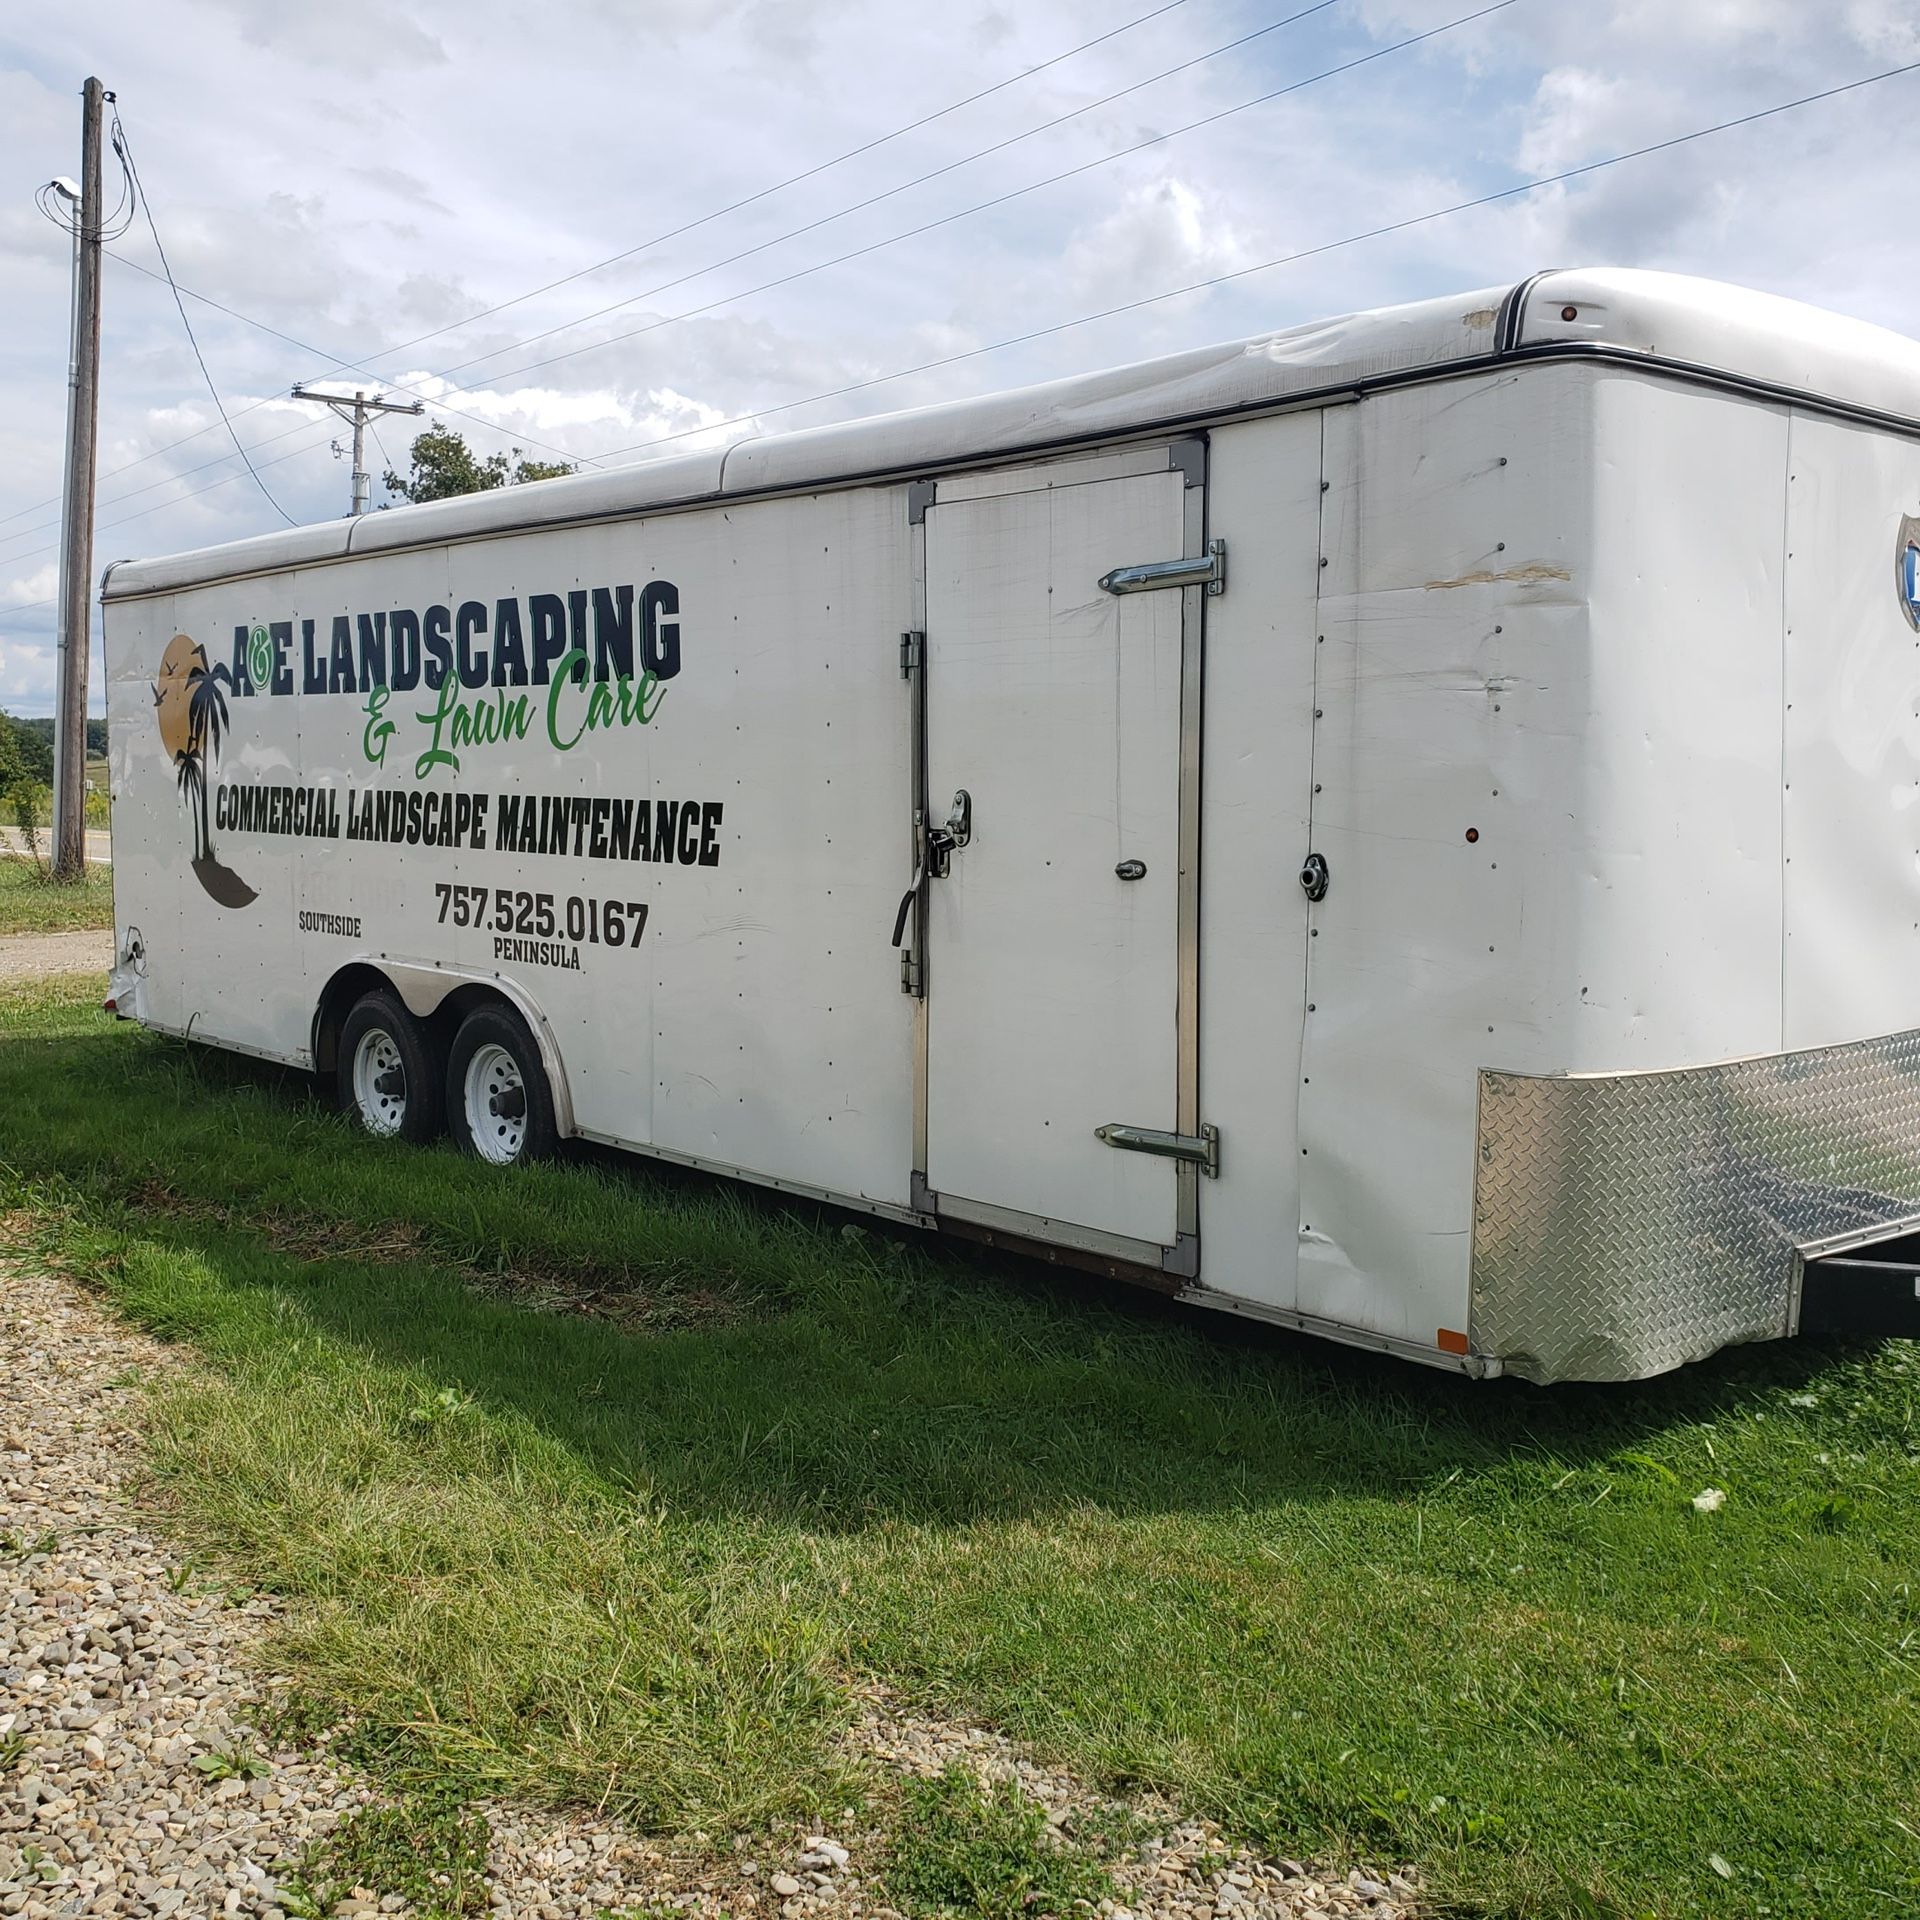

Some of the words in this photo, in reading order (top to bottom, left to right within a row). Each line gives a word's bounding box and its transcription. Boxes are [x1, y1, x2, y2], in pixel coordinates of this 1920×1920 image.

[302, 580, 681, 695] LANDSCAPING
[362, 684, 397, 770] &
[415, 669, 537, 780] Lawn
[547, 648, 668, 751] Care
[216, 784, 341, 839] COMMERCIAL
[346, 789, 489, 850] LANDSCAPE
[496, 795, 724, 867] MAINTENANCE
[299, 911, 362, 939] SOUTHSIDE
[435, 883, 649, 949] 757.525.0167
[494, 937, 581, 970] PENINSULA
